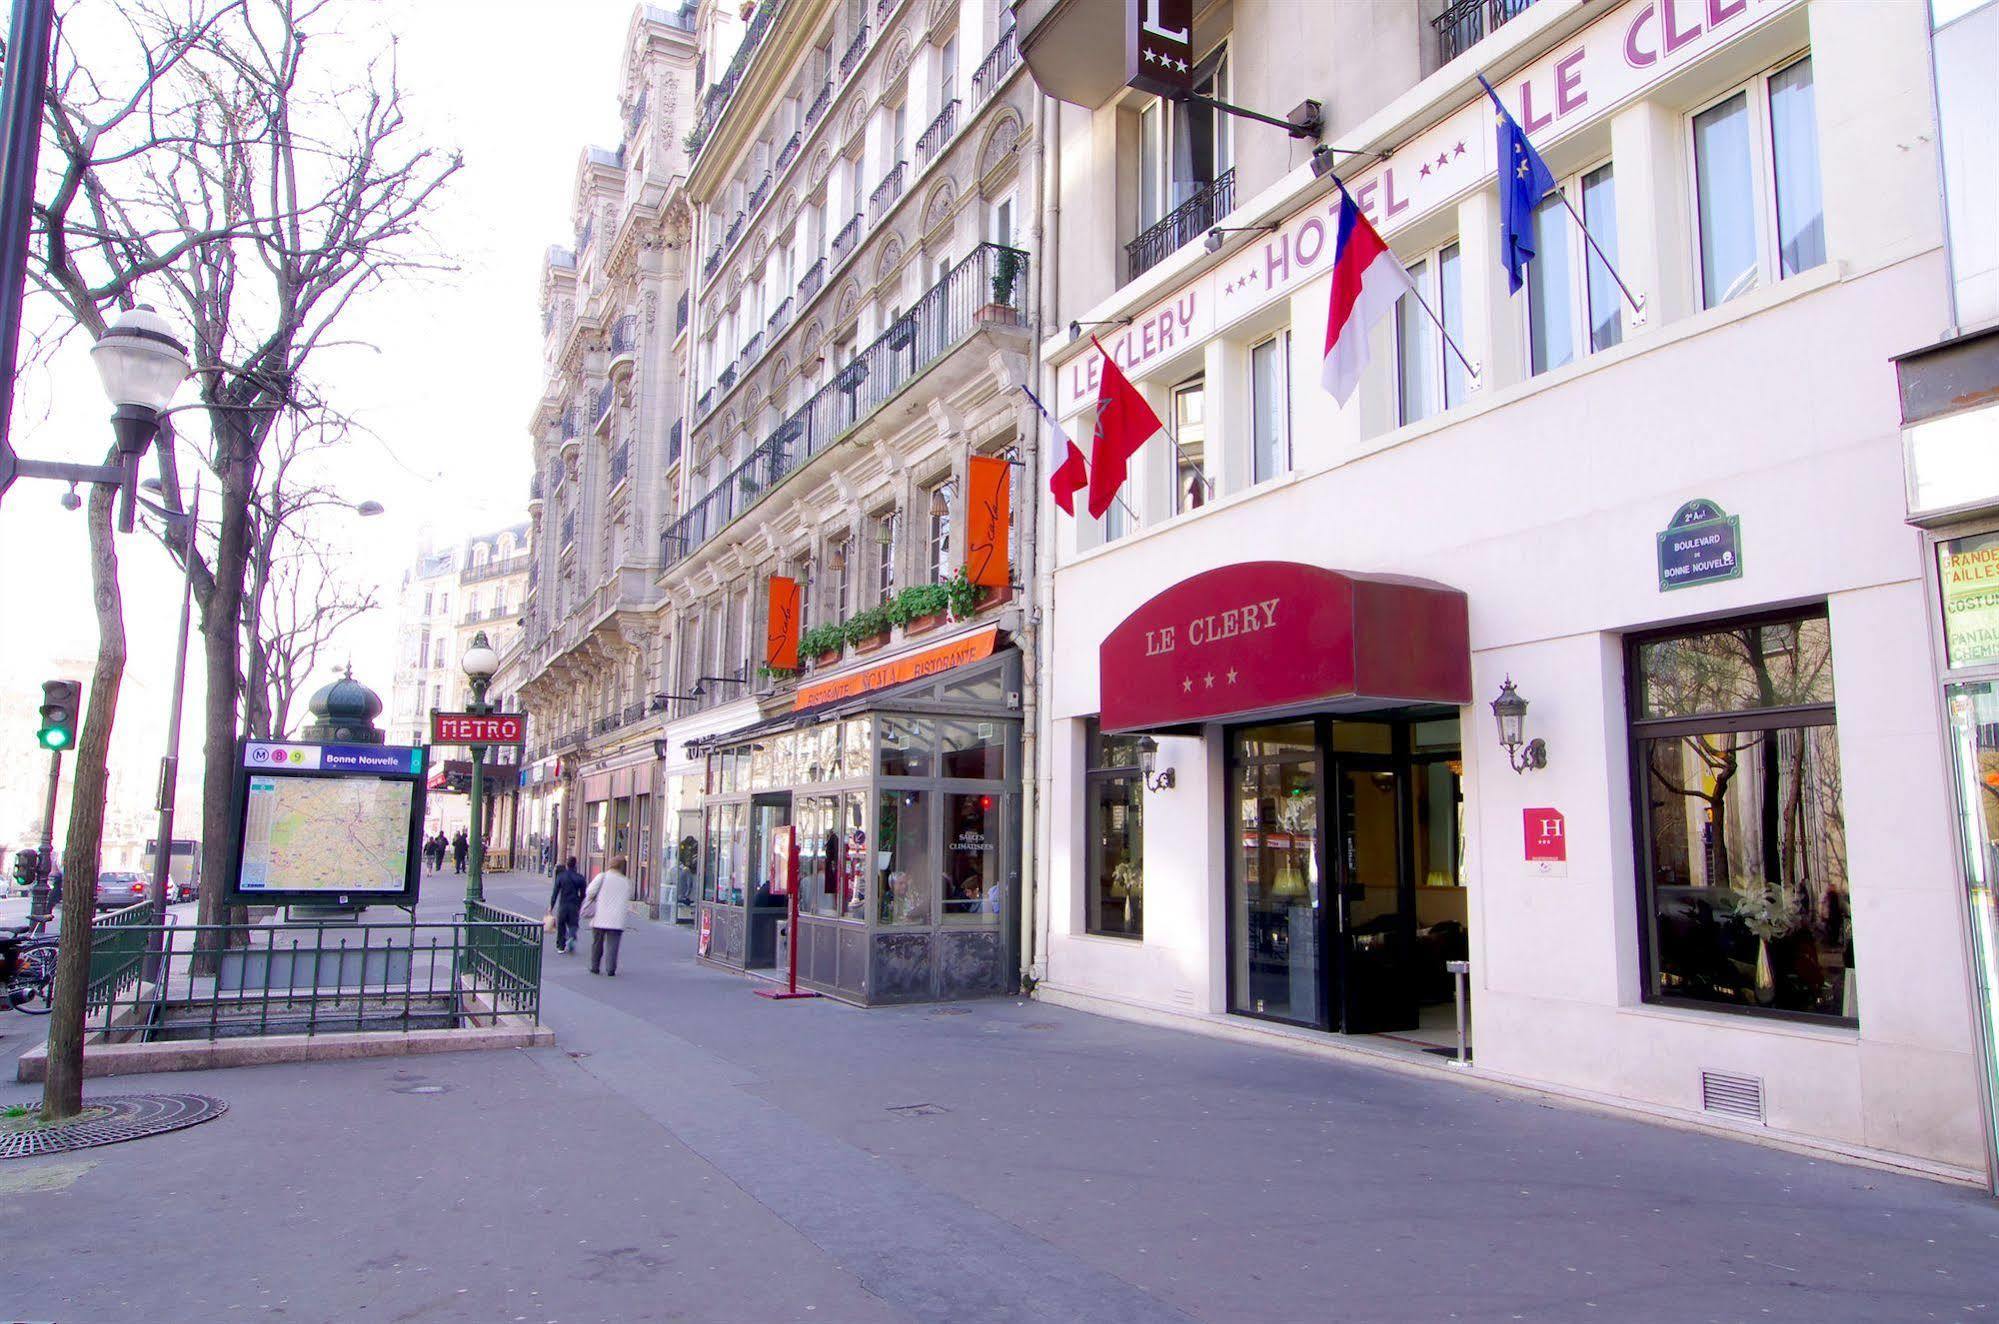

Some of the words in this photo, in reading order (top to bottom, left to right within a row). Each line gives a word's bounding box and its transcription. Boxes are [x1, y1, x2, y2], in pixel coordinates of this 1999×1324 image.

[1520, 45, 1588, 137] LE
[1074, 354, 1100, 400] LE
[1114, 292, 1196, 373] CLERY
[1674, 534, 1721, 552] BOULEVARD
[1664, 565, 1691, 578] BONNE
[1692, 556, 1735, 573] NOUVELLE
[1948, 593, 1999, 614] COSTU
[1145, 626, 1175, 657] LE
[1188, 598, 1280, 646] CLERY
[914, 646, 977, 678] RISTORANTE
[442, 719, 518, 739] METRO
[326, 754, 357, 765] Bonne
[359, 755, 399, 767] Nouvelle
[1540, 819, 1563, 837] H
